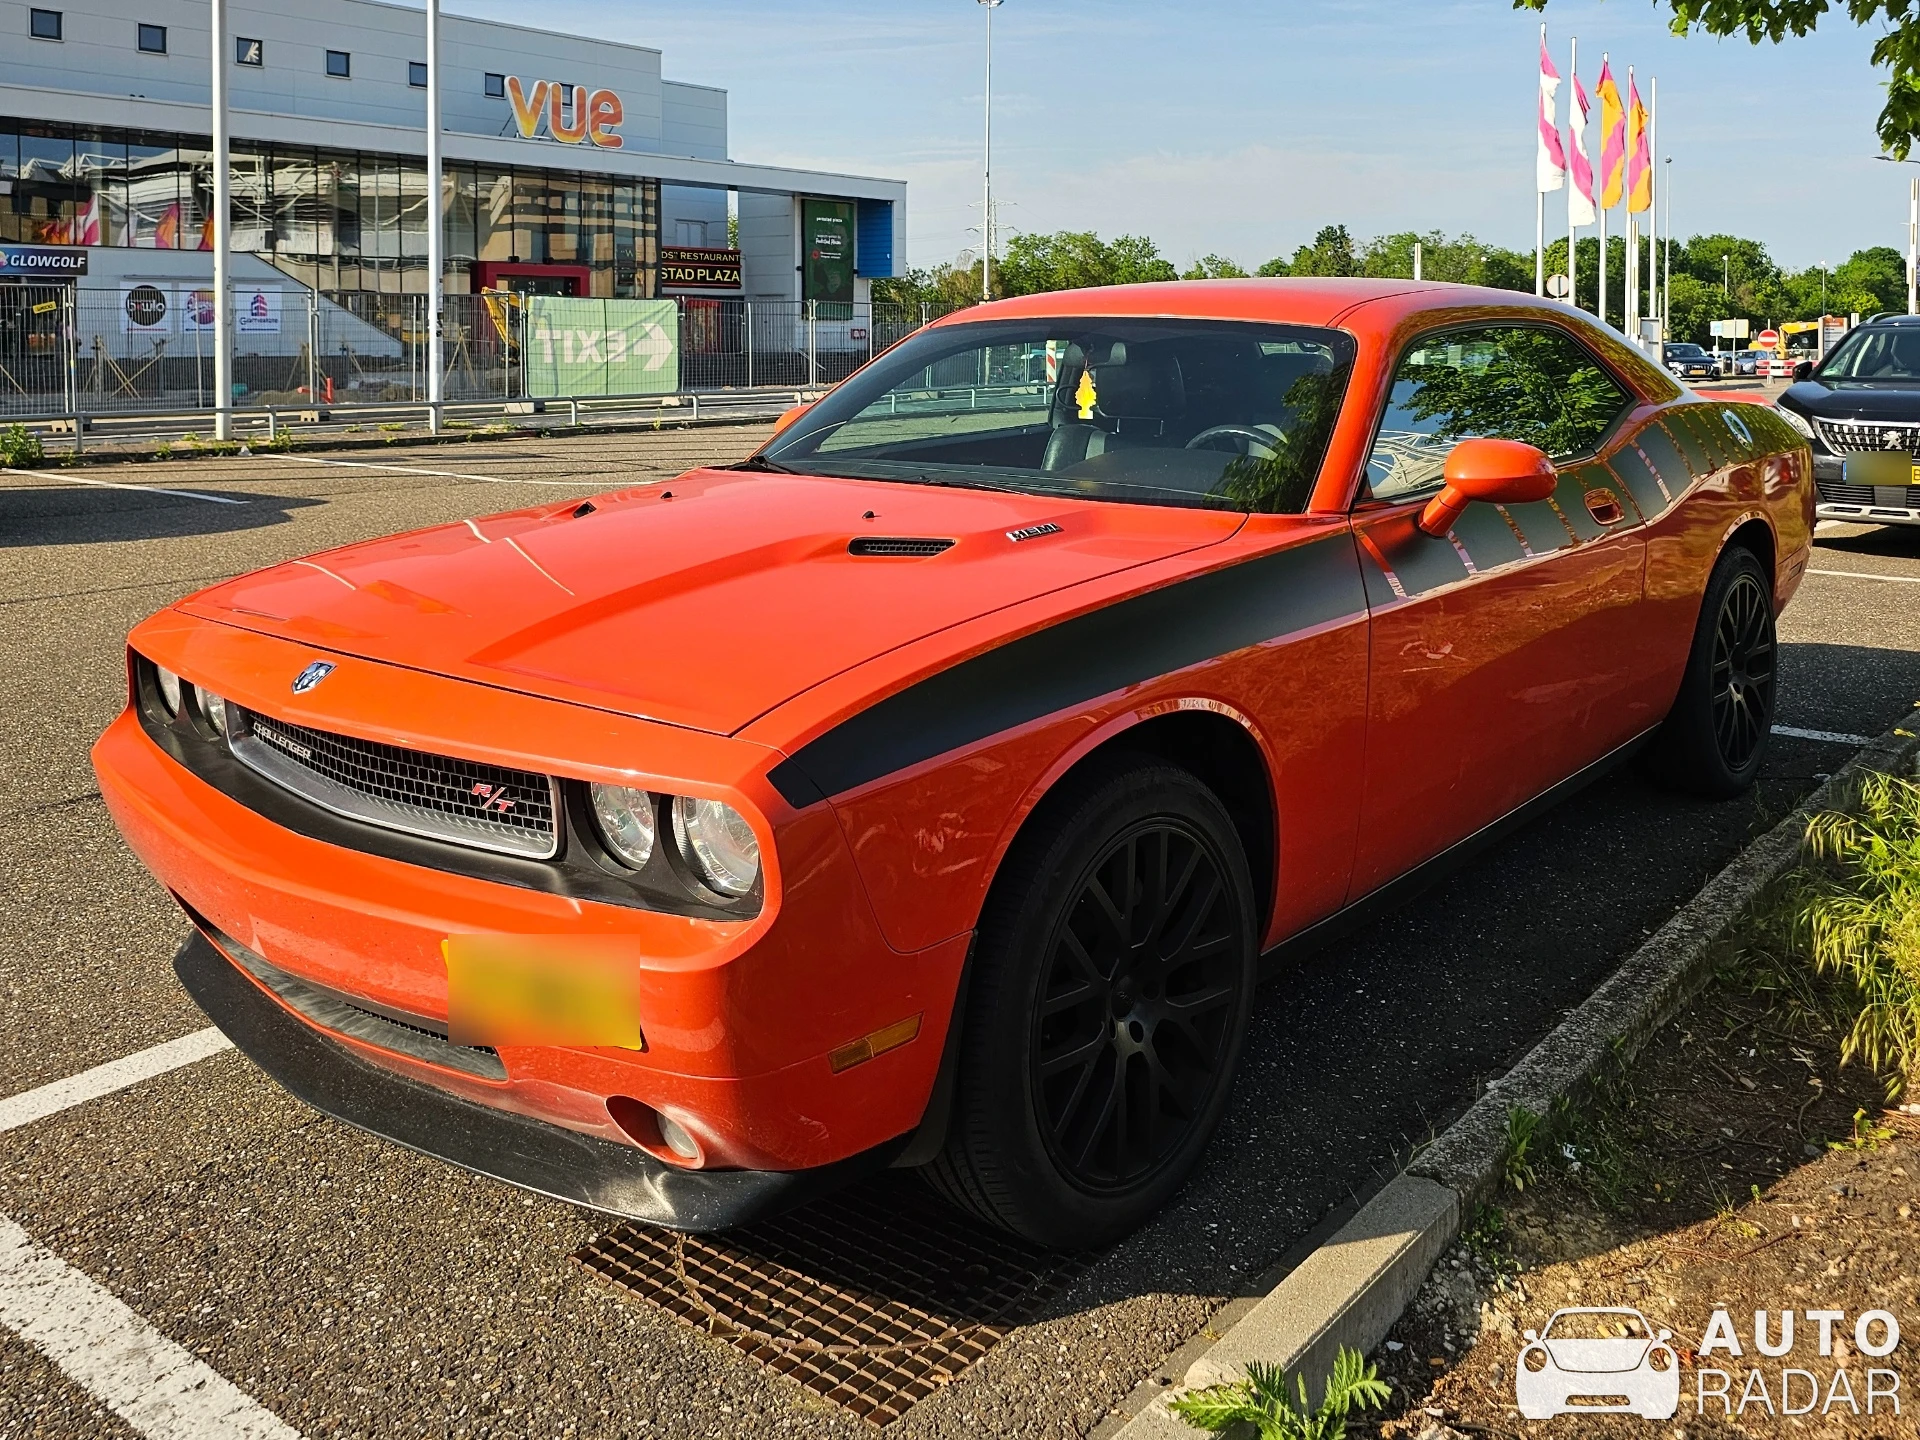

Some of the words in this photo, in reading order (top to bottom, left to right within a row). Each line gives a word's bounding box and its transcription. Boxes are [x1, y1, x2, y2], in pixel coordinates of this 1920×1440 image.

[10, 254, 86, 268] GLOWGOLF
[680, 252, 740, 262] RESTAURANT
[697, 269, 740, 282] PLAZA
[253, 721, 311, 760] CHALLENGER
[471, 783, 517, 814] R/T
